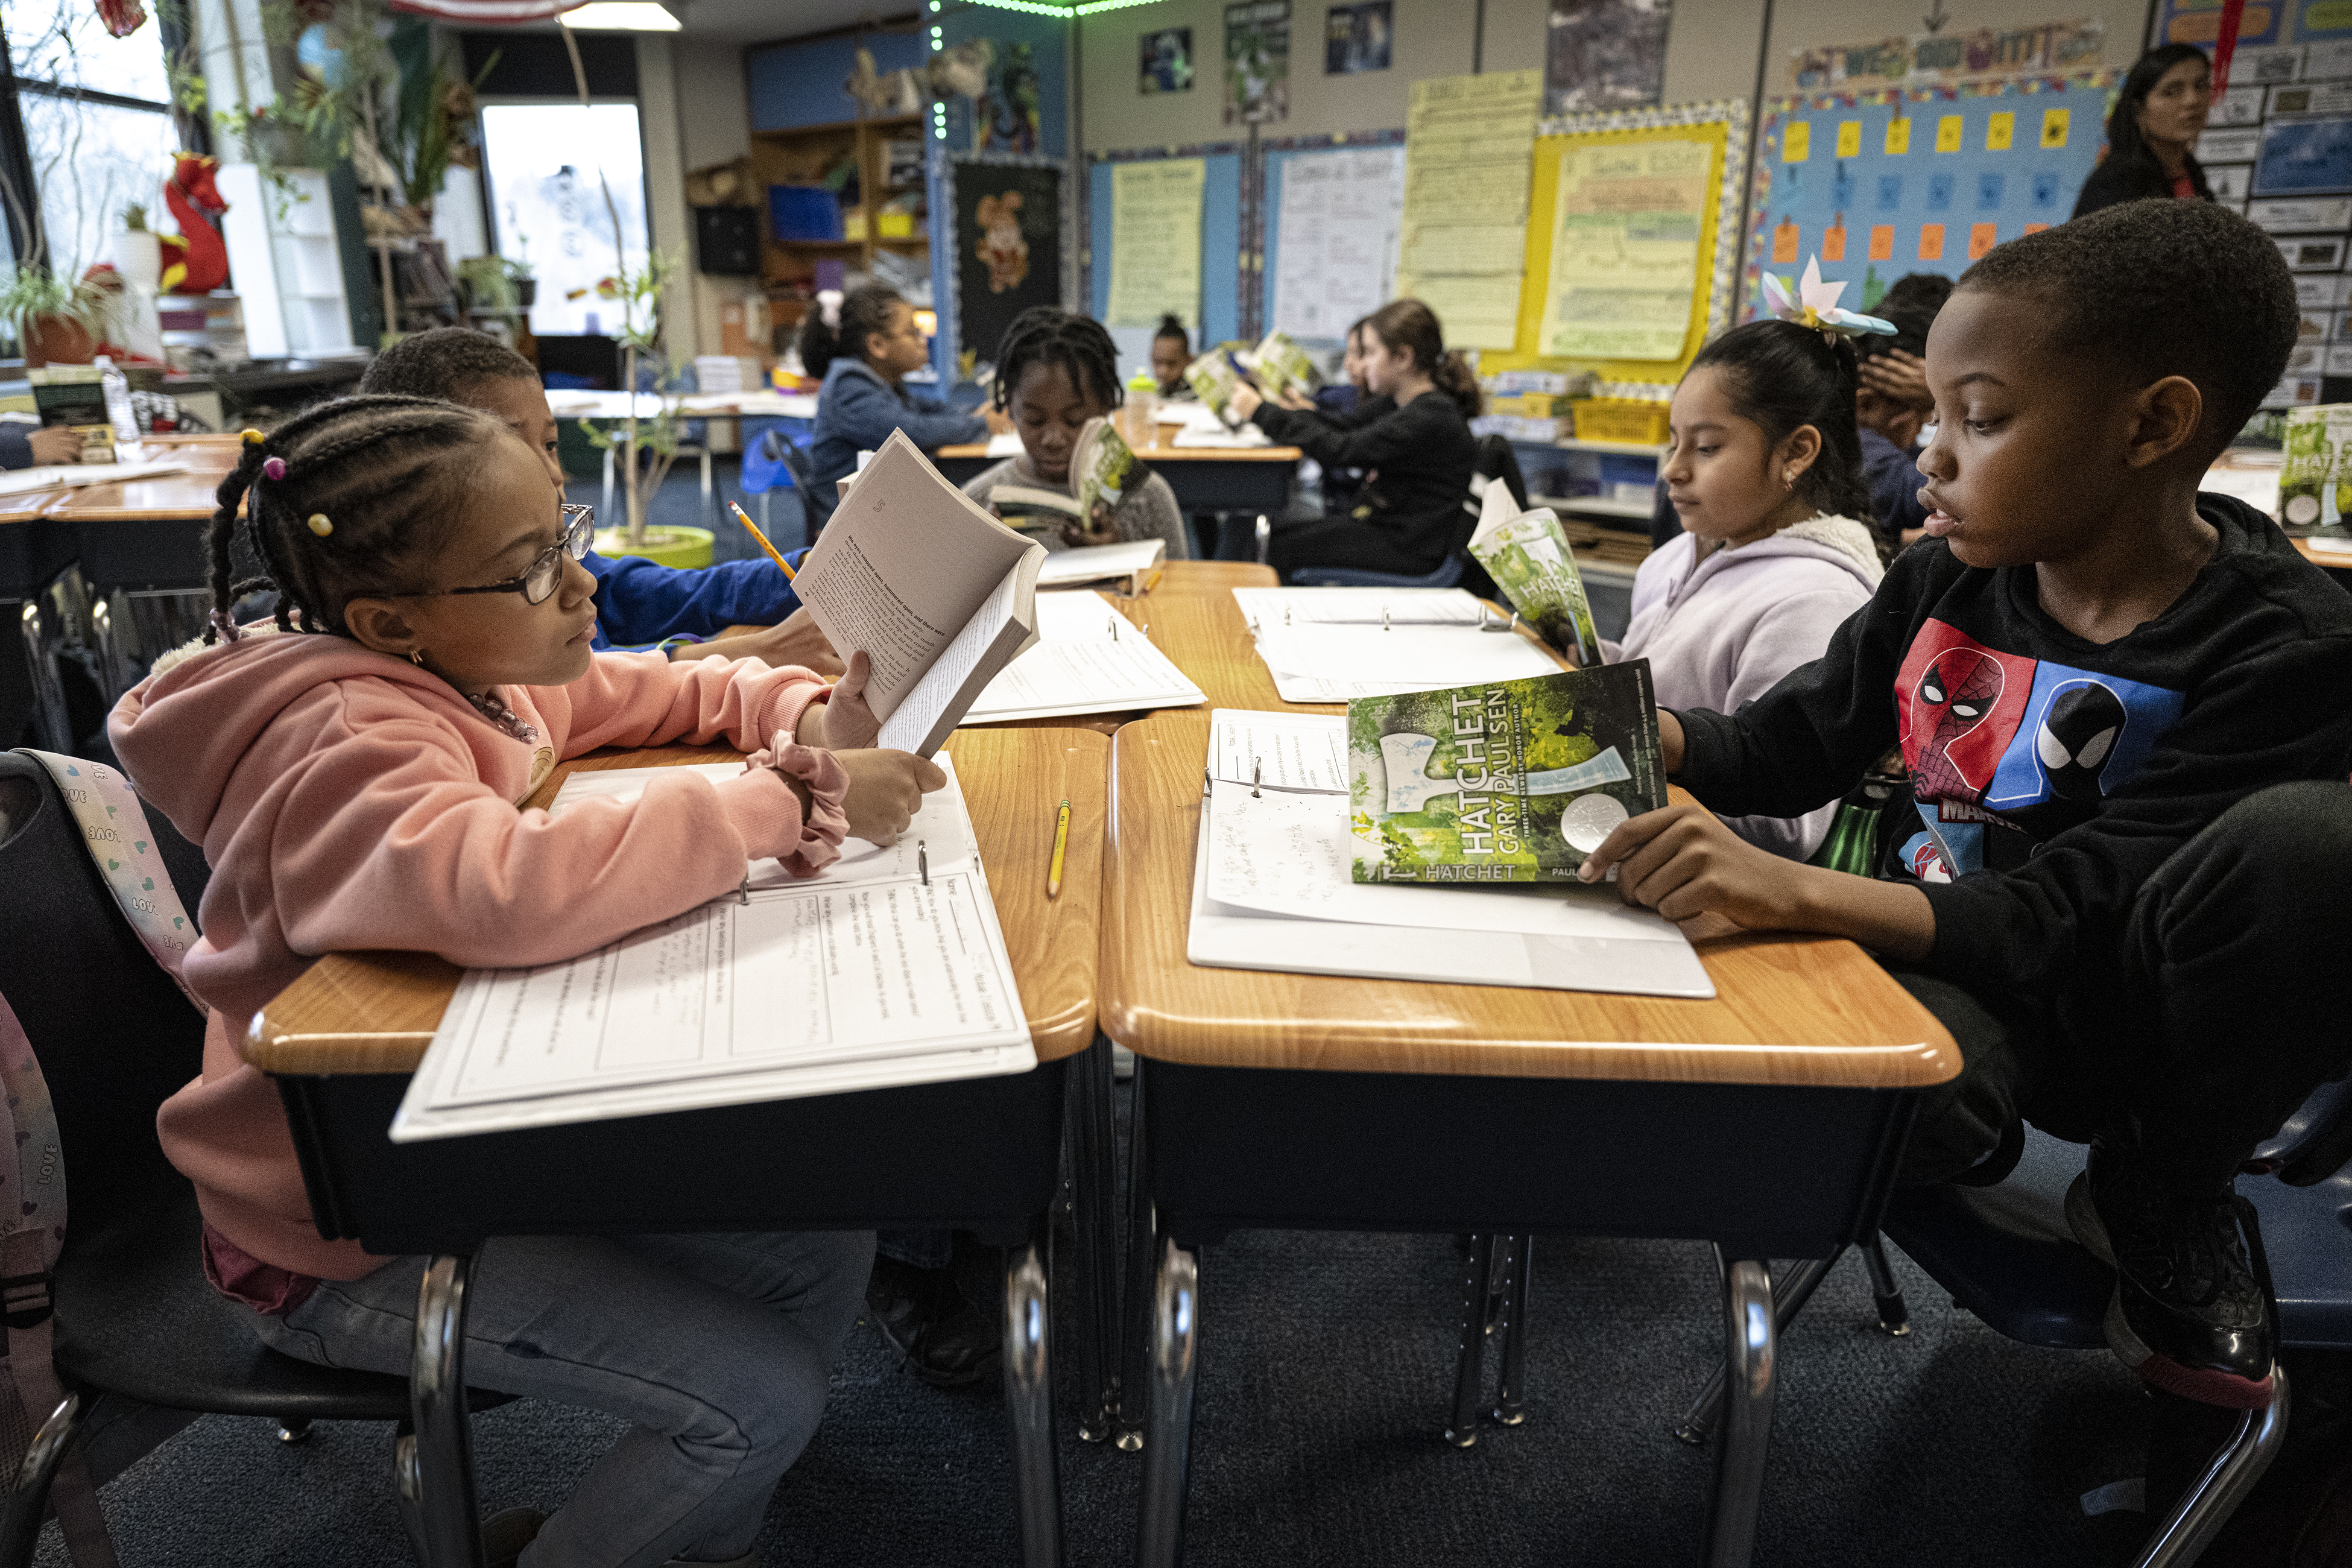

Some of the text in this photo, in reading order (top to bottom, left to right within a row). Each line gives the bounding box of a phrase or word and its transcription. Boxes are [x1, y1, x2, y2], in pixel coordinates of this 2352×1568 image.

[872, 499, 887, 513] 5
[844, 540, 853, 551] these
[853, 551, 862, 565] things
[862, 565, 871, 577] about
[871, 577, 884, 593] himself
[882, 592, 891, 601] that
[861, 554, 875, 572] snapped
[874, 572, 884, 584] open,
[884, 583, 903, 605] hammered
[902, 605, 912, 616] open,
[922, 621, 933, 630] there
[1519, 574, 1581, 598] HATCHET
[828, 560, 836, 571] Lots
[858, 605, 867, 617] water
[871, 624, 881, 636] could
[832, 557, 840, 567] some
[839, 568, 849, 580] water
[847, 580, 856, 590] soon
[874, 620, 887, 633] would
[885, 633, 898, 645] wither
[855, 574, 865, 587] tasted
[903, 633, 913, 642] were
[913, 641, 929, 652] cracked
[849, 599, 858, 611] thirst
[874, 637, 883, 648] burn
[859, 590, 868, 600] were
[867, 600, 882, 619] bleeding
[912, 648, 925, 657] drink
[879, 599, 895, 616] viciously
[920, 637, 934, 647] mouth
[871, 641, 880, 653] come
[879, 653, 888, 662] over
[888, 662, 896, 671] him
[1452, 694, 1494, 854] HATCHET
[1486, 688, 1520, 855] GARY PAULSEN
[1520, 798, 1529, 837] THREE-TIME
[1426, 865, 1578, 880] HATCHET PAUL
[132, 897, 158, 915] LOV
[37, 1143, 58, 1185] LOVE
